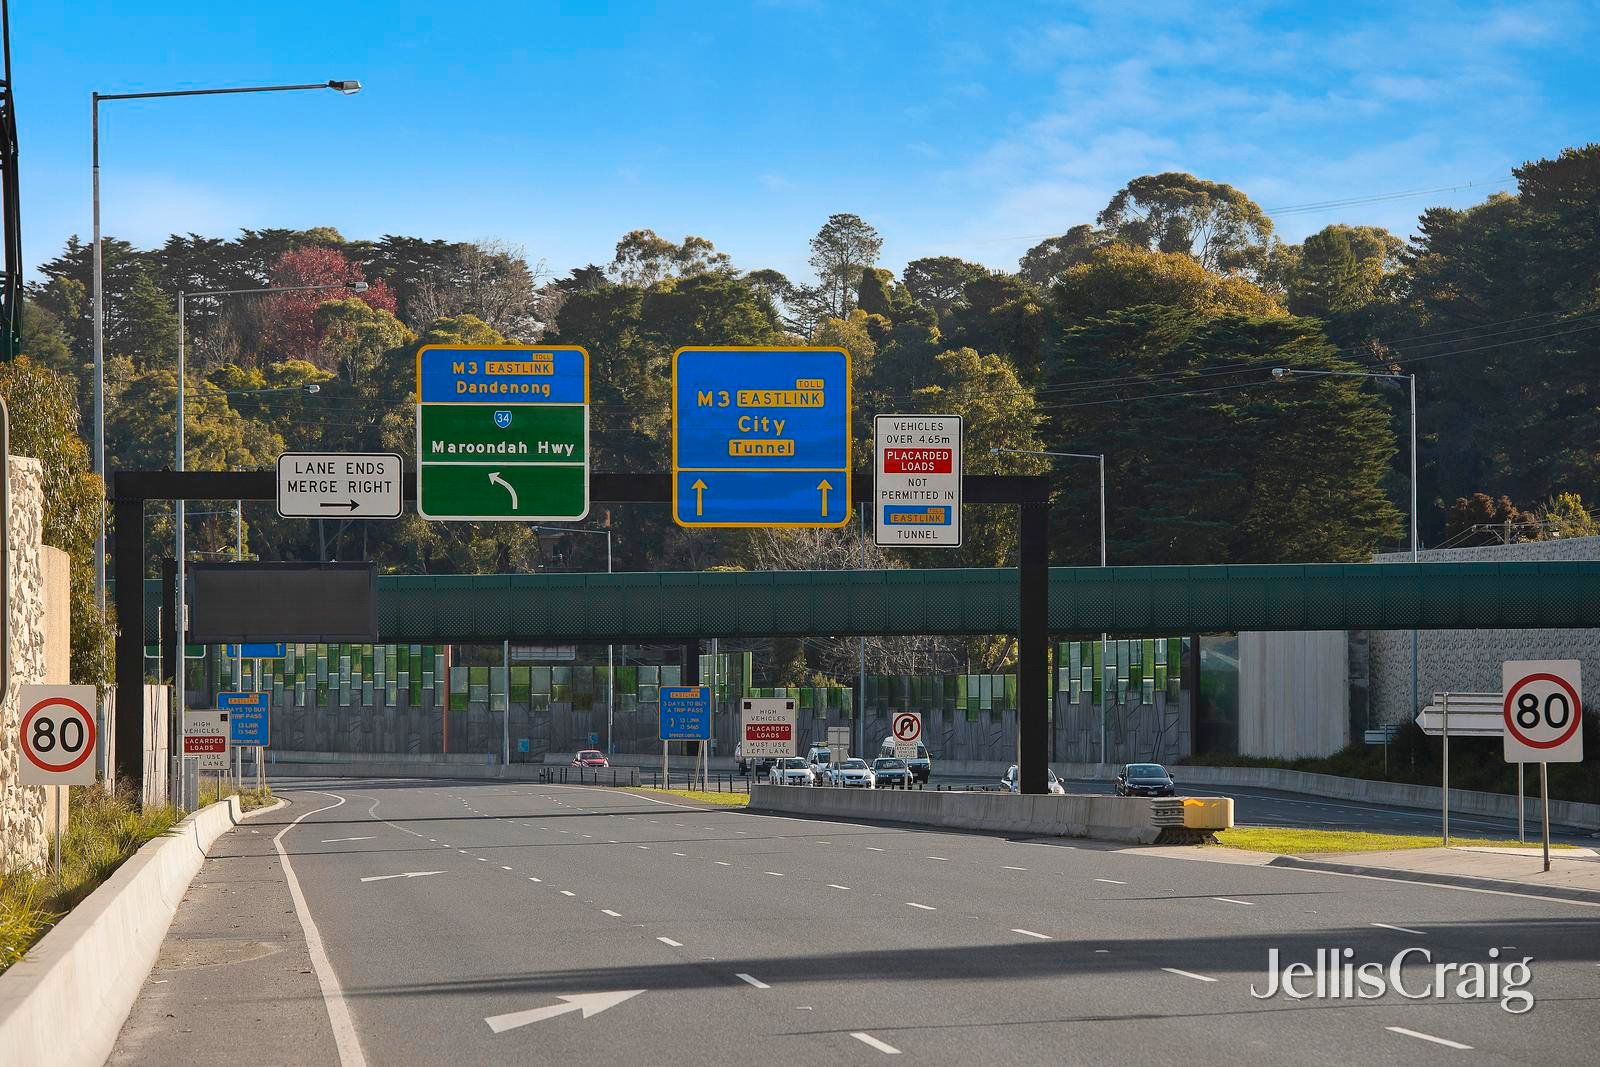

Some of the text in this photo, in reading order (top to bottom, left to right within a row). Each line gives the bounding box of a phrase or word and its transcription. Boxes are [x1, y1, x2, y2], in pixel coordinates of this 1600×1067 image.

[488, 362, 552, 374] EASTLINK
[456, 380, 551, 398] Dandenong
[740, 392, 821, 406] EASTLINK
[496, 413, 510, 424] 34
[738, 415, 786, 436] City
[893, 422, 944, 432] VEHICLES
[886, 434, 950, 444] OVER 4.65m
[431, 440, 575, 457] Maroondah Hwy
[732, 441, 792, 454] Tunnel
[886, 451, 950, 460] PLACARDED
[294, 462, 385, 476] LANE ENDS
[900, 462, 935, 471] LOADS
[287, 480, 392, 494] MERGE RIGHT
[908, 478, 928, 488] NOT
[881, 490, 954, 500] PERMITTED IN
[893, 514, 942, 522] EASTLINK
[897, 530, 938, 540] TUNNEL
[1516, 692, 1570, 730] 80
[33, 717, 84, 752] 80
